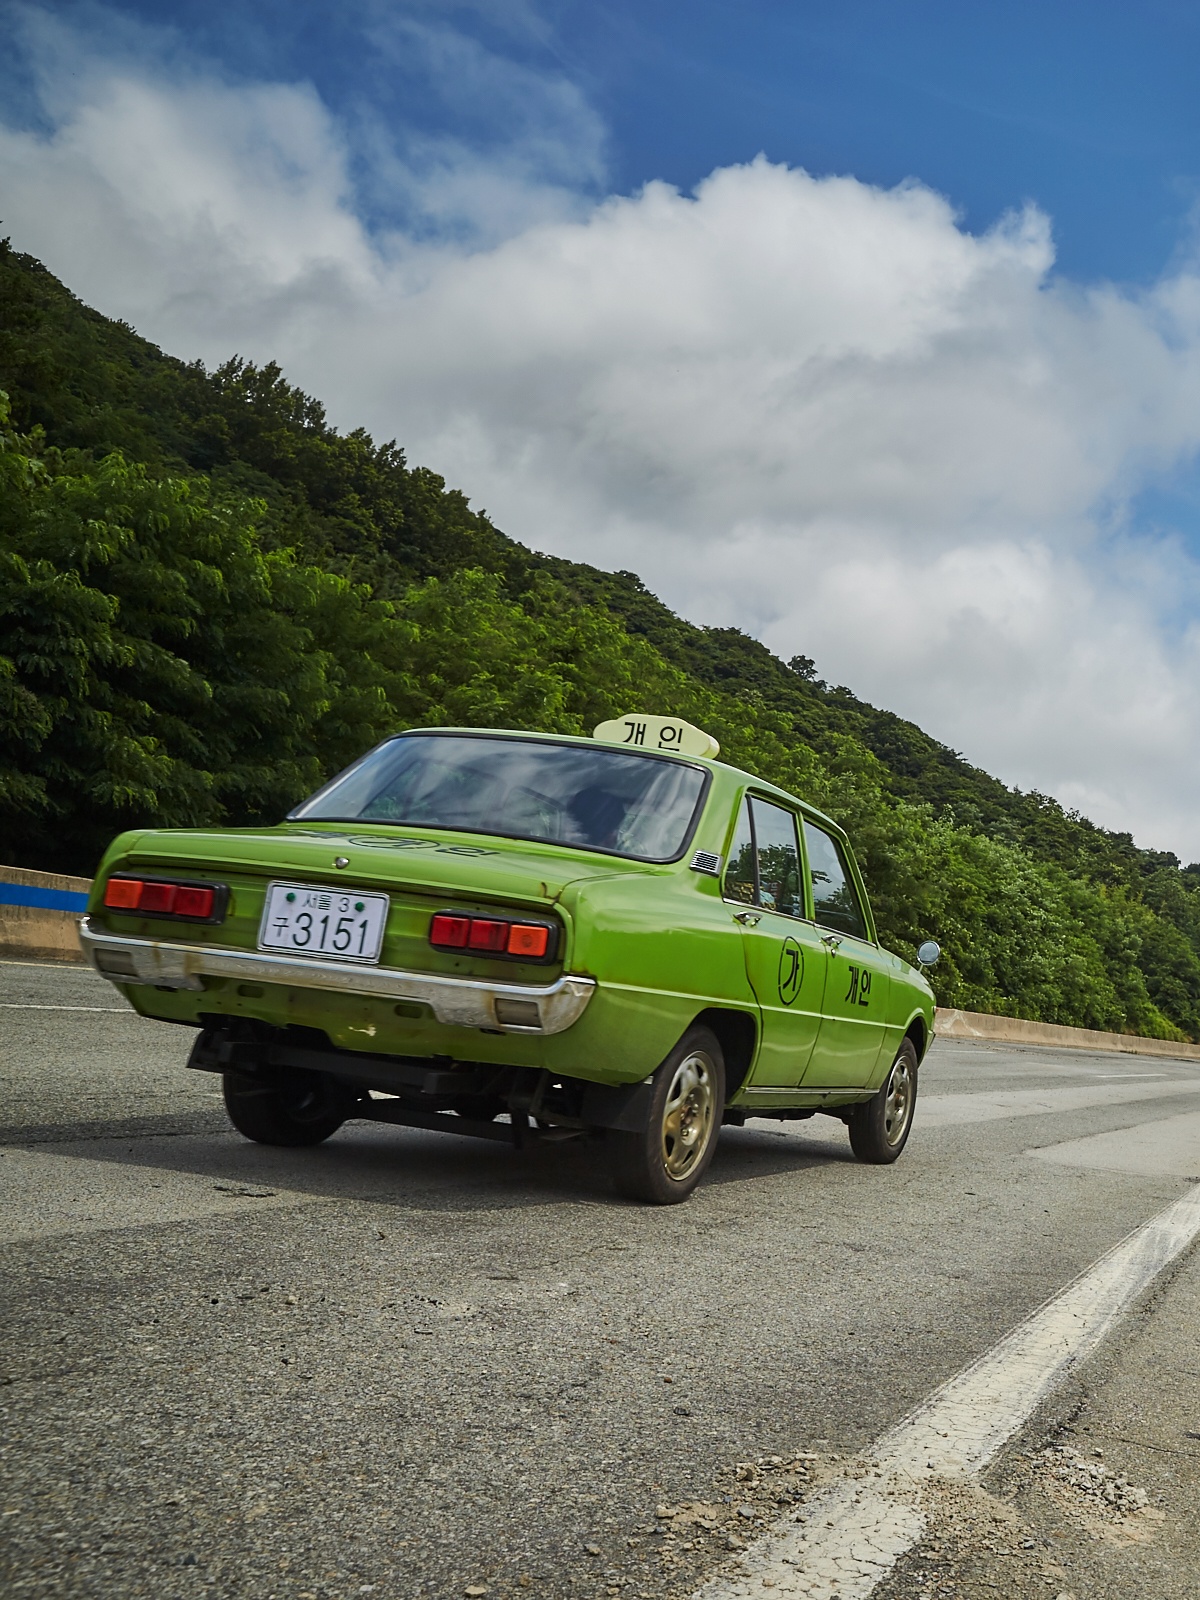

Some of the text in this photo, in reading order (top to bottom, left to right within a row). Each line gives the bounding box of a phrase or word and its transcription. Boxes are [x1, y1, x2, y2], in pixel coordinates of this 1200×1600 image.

[302, 893, 350, 913] 서울 3
[292, 912, 368, 955] 3151
[845, 965, 872, 1007] 개인
